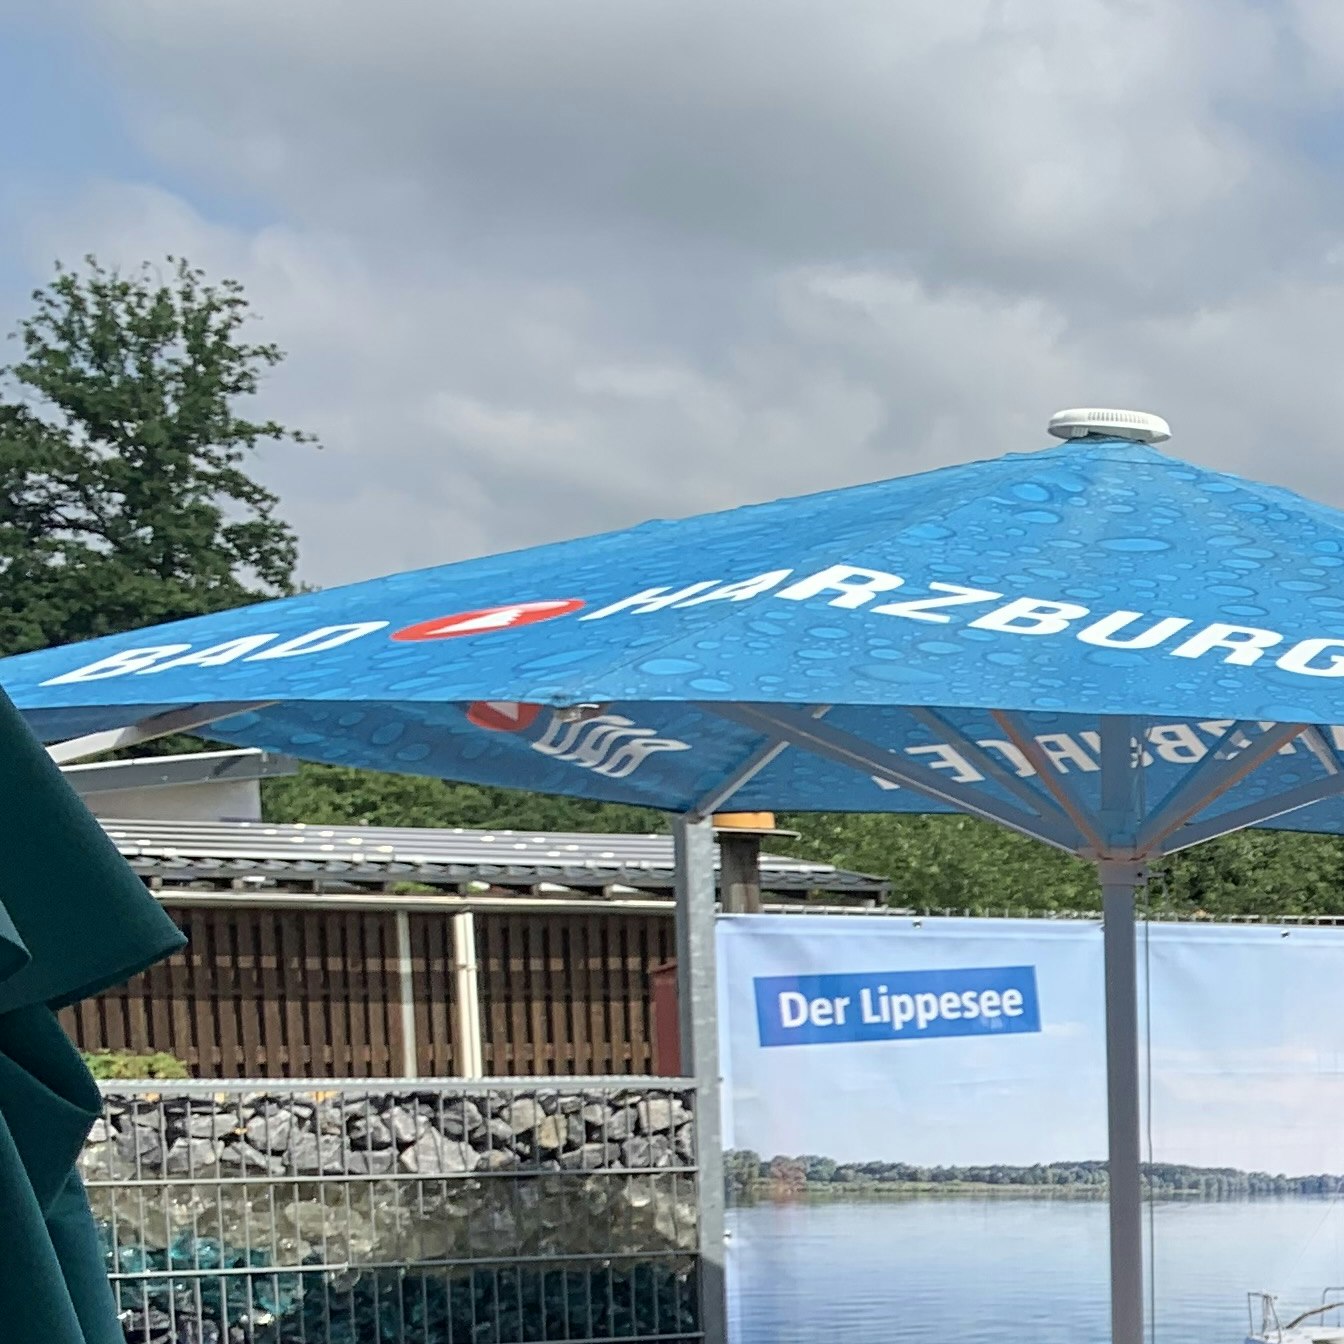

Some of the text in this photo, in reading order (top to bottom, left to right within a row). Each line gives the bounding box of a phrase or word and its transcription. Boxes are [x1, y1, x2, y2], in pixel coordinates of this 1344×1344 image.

[39, 620, 391, 686] BAD
[779, 984, 1025, 1032] Der Lippesee
